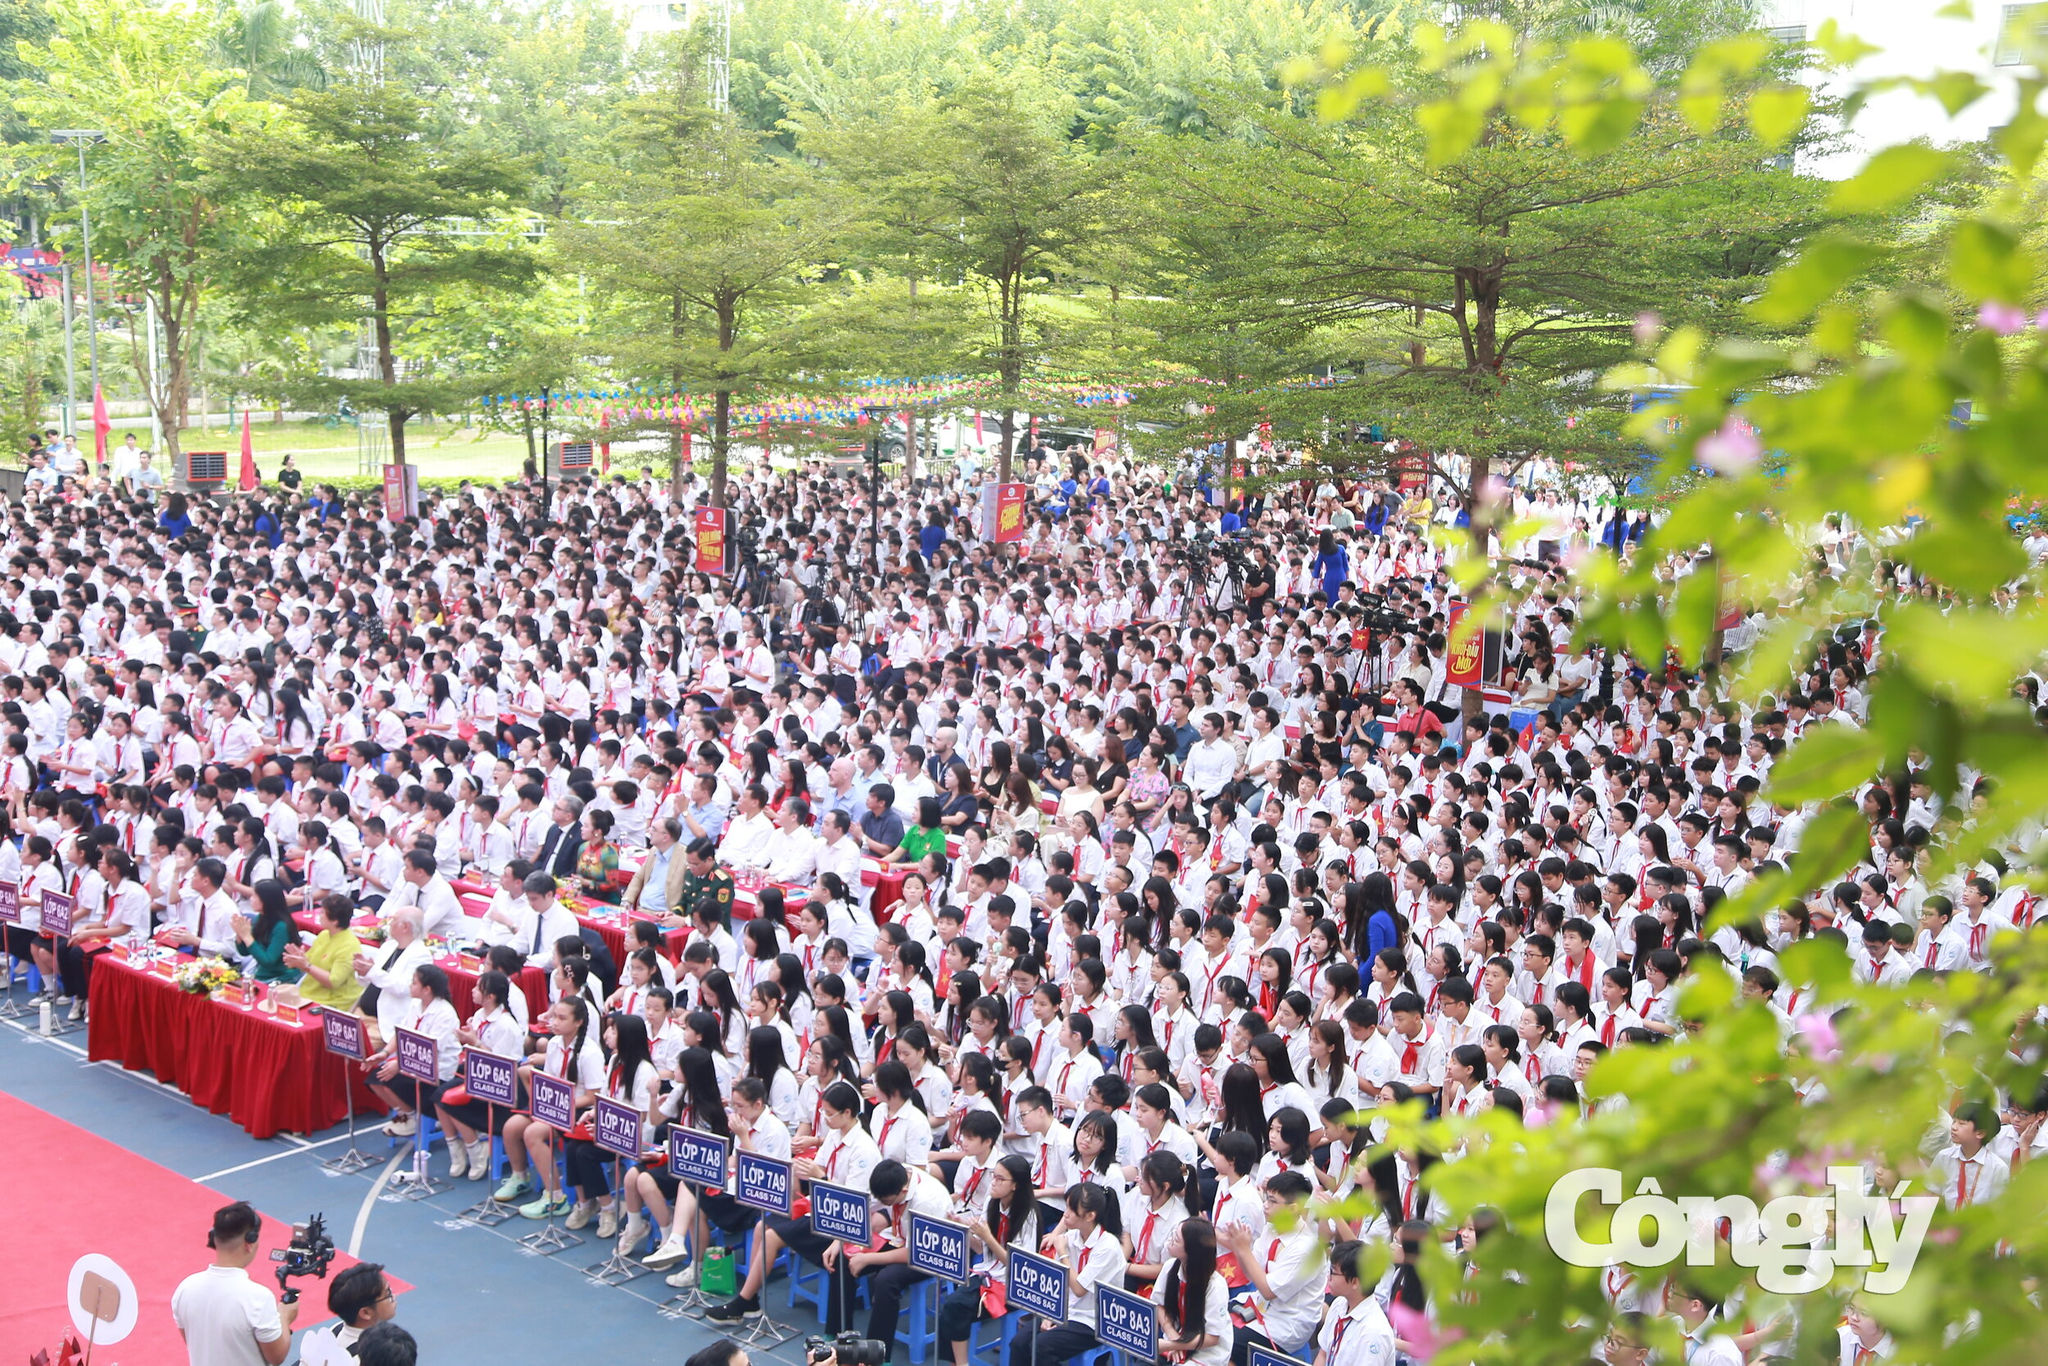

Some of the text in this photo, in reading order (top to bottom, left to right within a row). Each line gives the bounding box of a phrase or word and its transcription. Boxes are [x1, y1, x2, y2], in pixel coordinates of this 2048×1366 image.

[44, 898, 68, 920] LỚP 6A2
[326, 1015, 357, 1042] LỚP 6A7
[400, 1037, 432, 1064] LỚP 6A6
[471, 1059, 511, 1086] LỚP 6A5
[536, 1083, 570, 1112] LỚP 7A6
[600, 1109, 636, 1138] LỚP 7A7
[602, 1132, 621, 1146] CLASS
[676, 1138, 720, 1168] LỚP 7A8
[678, 1162, 702, 1176] CLASS
[742, 1163, 786, 1193] LỚP 7A9
[745, 1188, 768, 1201] CLASS
[817, 1193, 864, 1224] LỚP 8A0
[821, 1218, 846, 1232] CLASS
[916, 1226, 962, 1260] LỚP 8A1
[918, 1253, 943, 1268] CLASS
[1014, 1260, 1060, 1300] LỚP 8A2
[1016, 1288, 1041, 1306] CLASS
[1103, 1297, 1150, 1336] LỚP 8A3
[1106, 1325, 1131, 1344] CLASS
